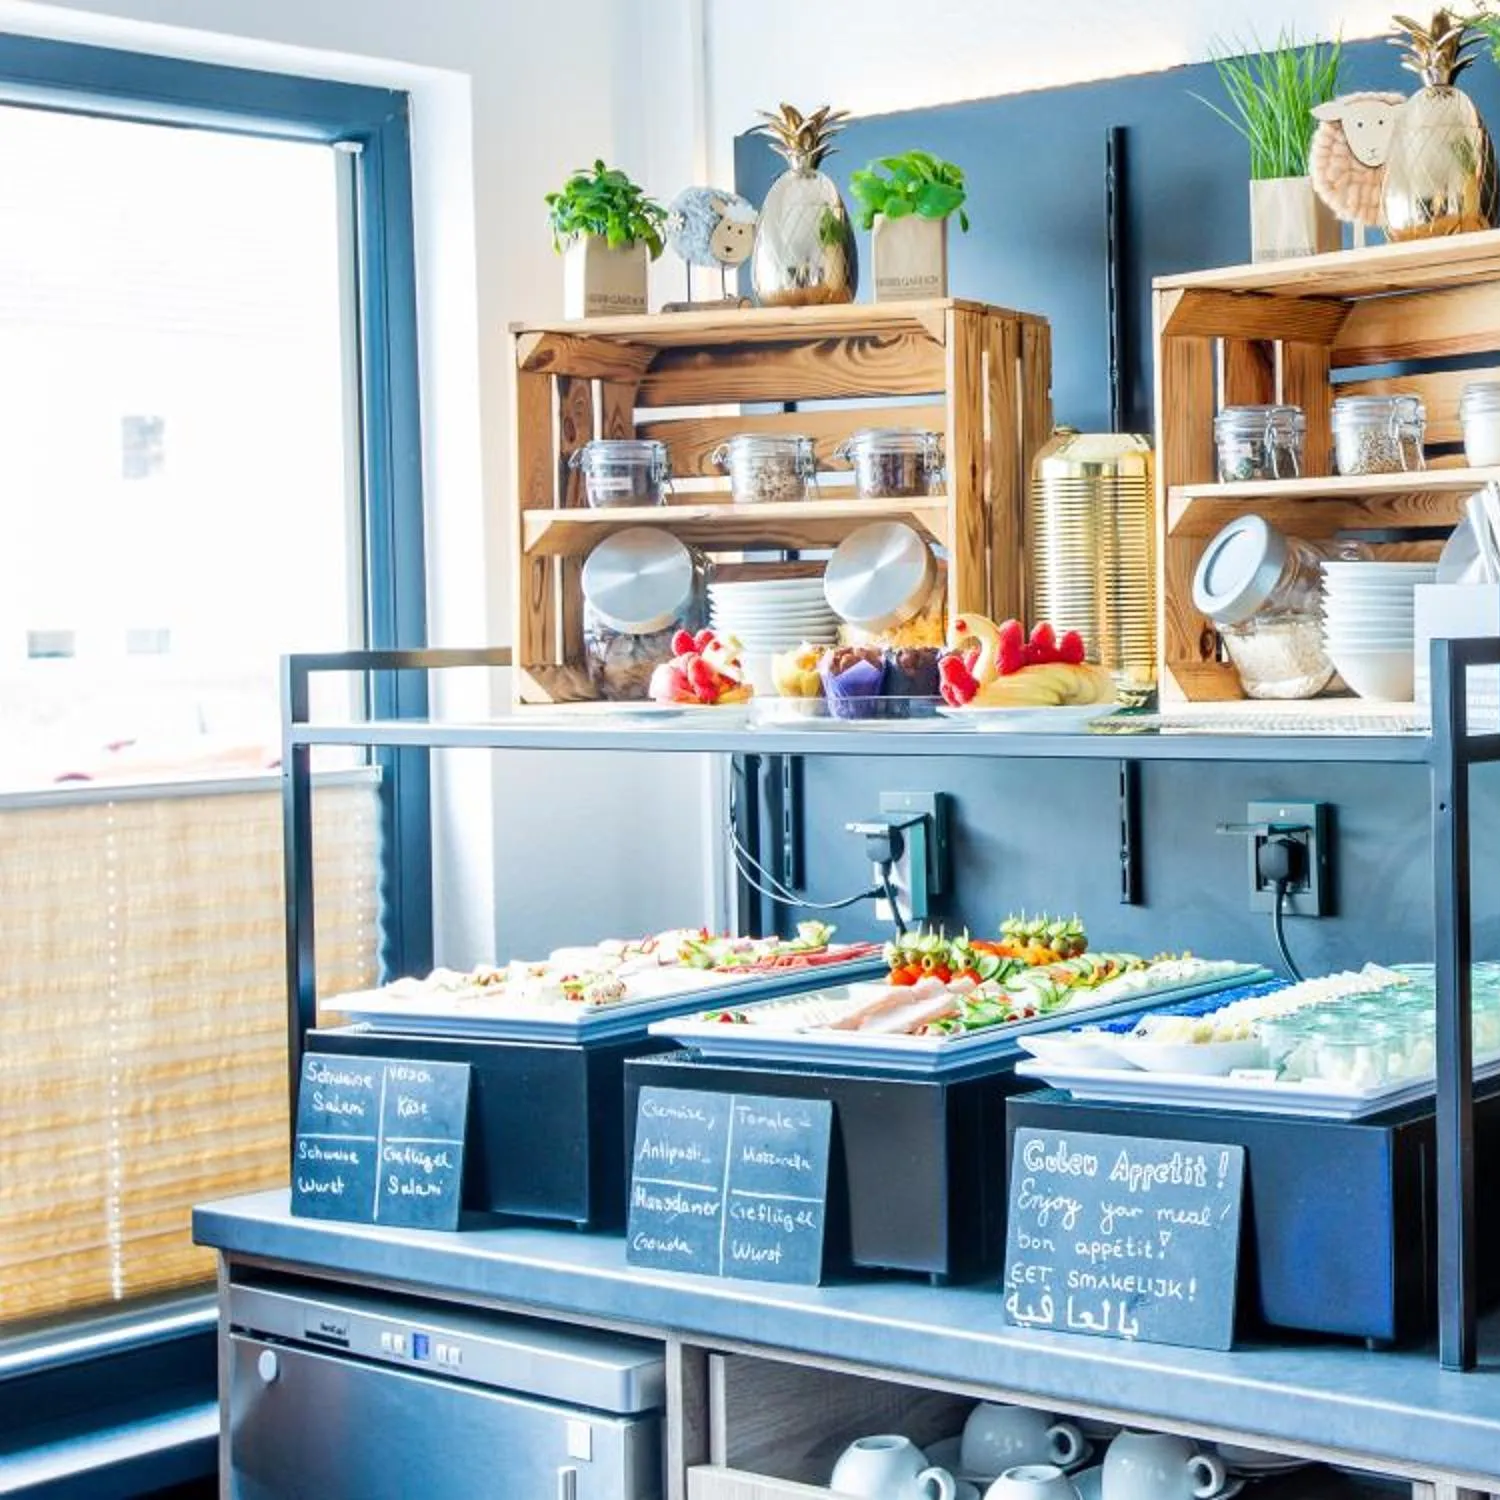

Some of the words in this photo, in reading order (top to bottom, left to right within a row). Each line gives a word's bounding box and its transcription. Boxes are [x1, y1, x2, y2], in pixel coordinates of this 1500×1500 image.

[1023, 1138, 1098, 1177] Guten
[298, 1175, 345, 1195] Wurst
[388, 1175, 443, 1196] Salami
[1018, 1177, 1083, 1231] Enjoy
[730, 1202, 816, 1233] Geflügel
[633, 1231, 692, 1255] Gouda
[1017, 1228, 1055, 1252] bon
[732, 1240, 783, 1265] Wurst
[1011, 1261, 1053, 1283] EET
